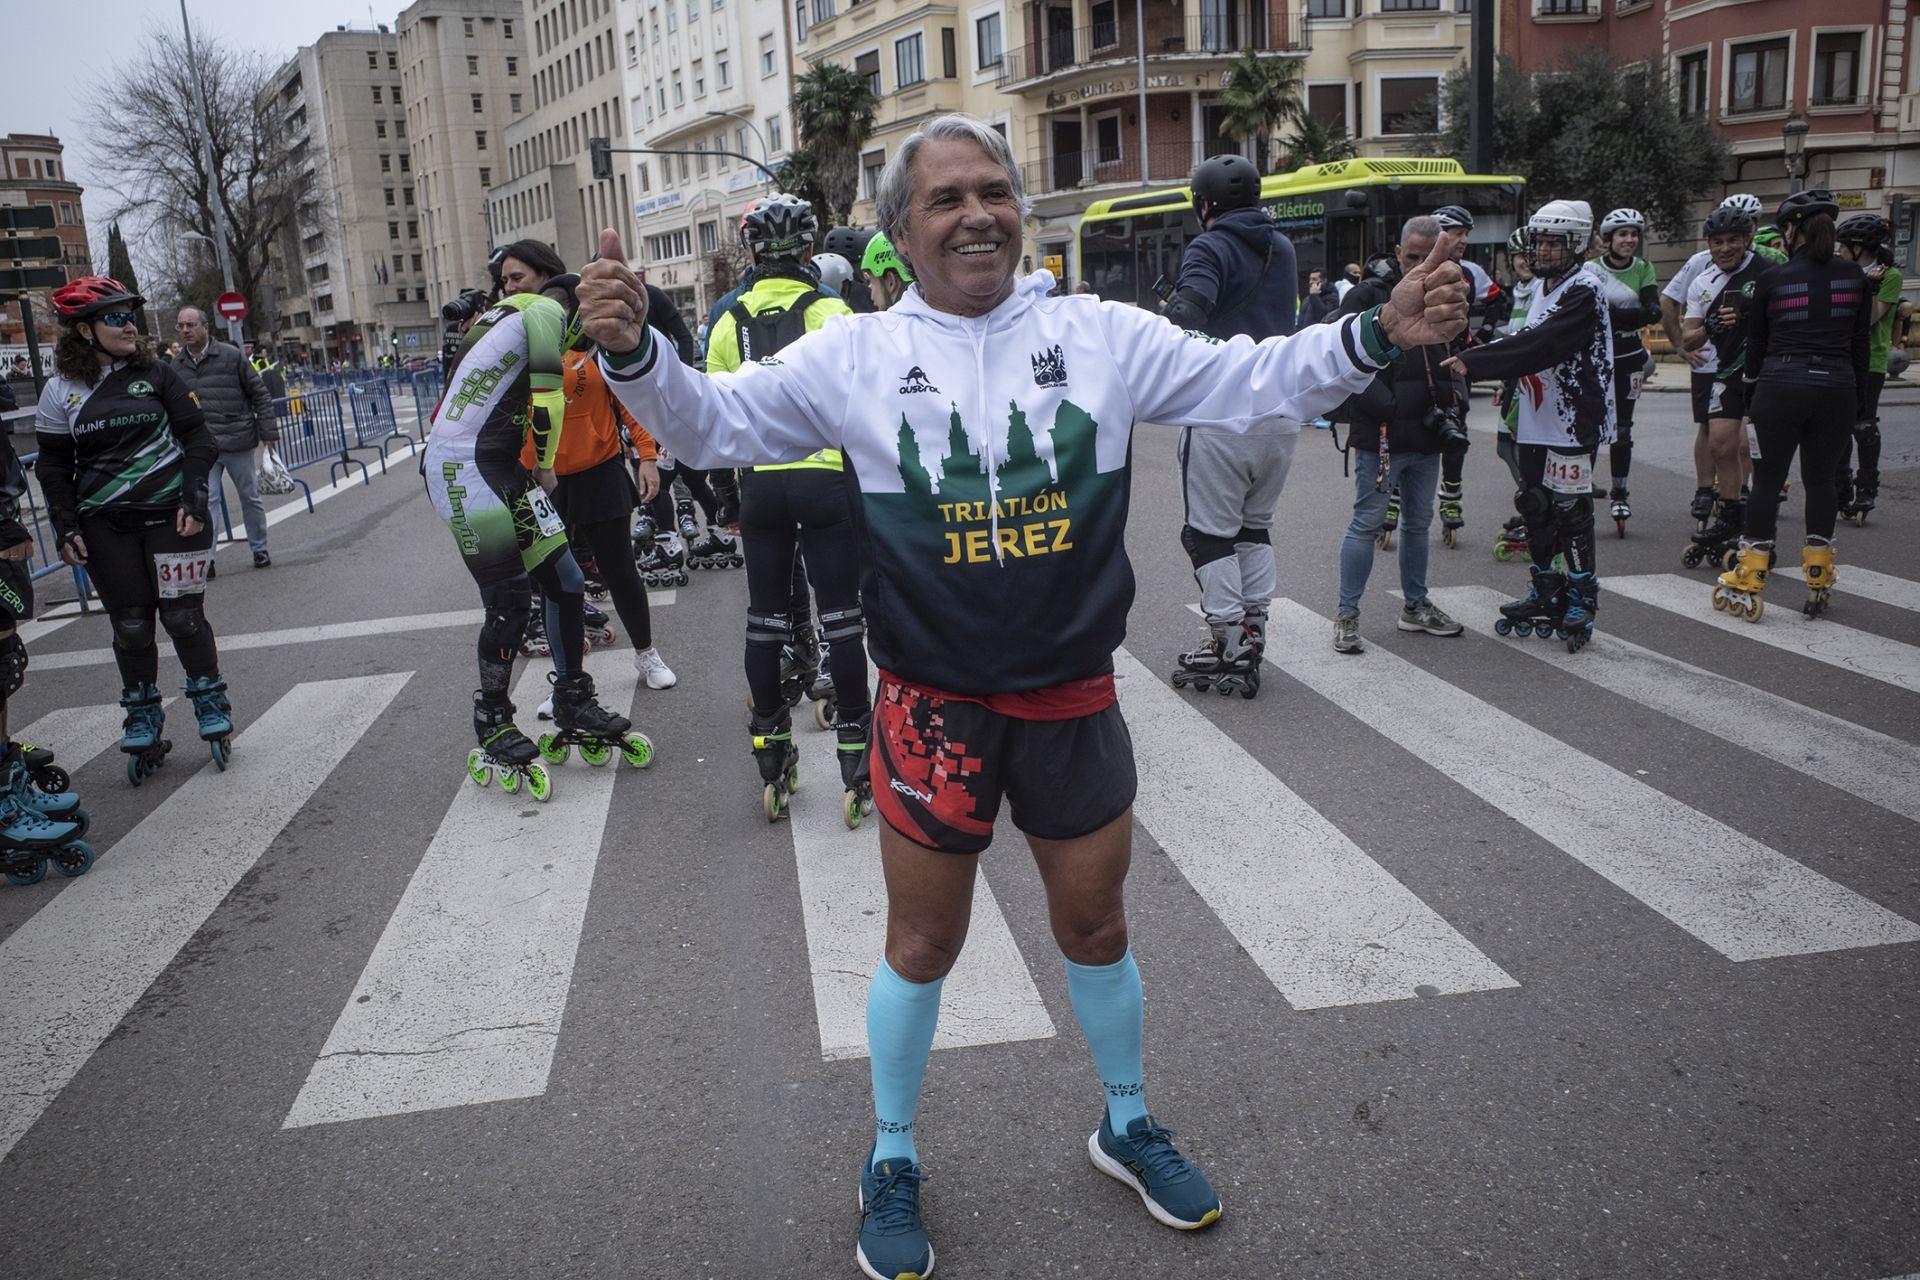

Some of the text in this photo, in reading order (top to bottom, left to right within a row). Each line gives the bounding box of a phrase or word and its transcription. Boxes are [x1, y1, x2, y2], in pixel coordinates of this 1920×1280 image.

[1128, 75, 1185, 93] DNTAL
[1277, 201, 1325, 219] Eléctrico
[741, 326, 750, 362] RIDER
[109, 413, 159, 428] BADAJOZ
[1546, 458, 1580, 480] 3113
[938, 488, 1067, 522] TRIATLÓN
[944, 518, 1073, 564] JEREZ
[160, 560, 207, 582] 3117
